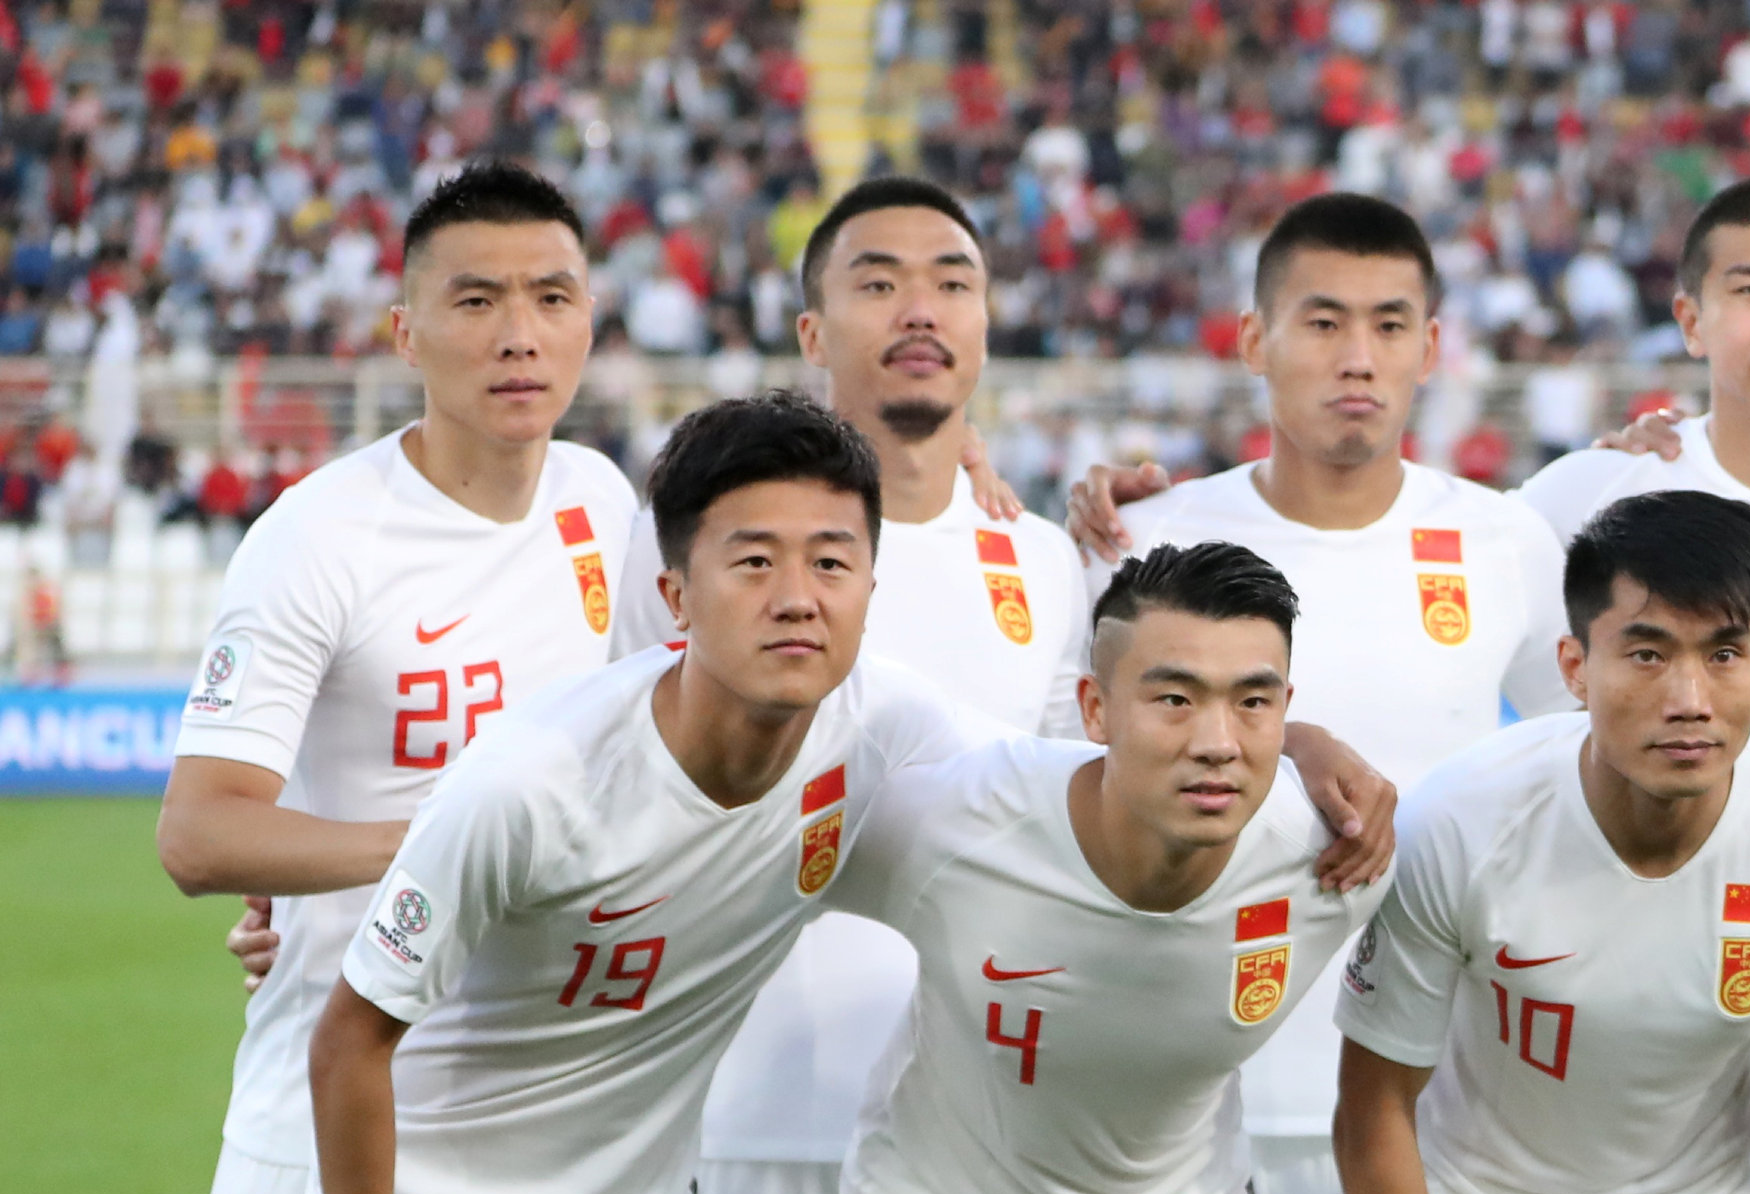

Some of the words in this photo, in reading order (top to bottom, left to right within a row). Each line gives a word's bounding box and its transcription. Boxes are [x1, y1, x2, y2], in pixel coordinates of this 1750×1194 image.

[393, 660, 504, 769] 22
[804, 815, 841, 845] CFA
[373, 919, 401, 948] ASIAN
[400, 945, 423, 963] CUP
[557, 936, 666, 1012] 19
[1240, 951, 1285, 972] CFA
[986, 1002, 1042, 1086] 4
[1490, 980, 1575, 1082] 10
